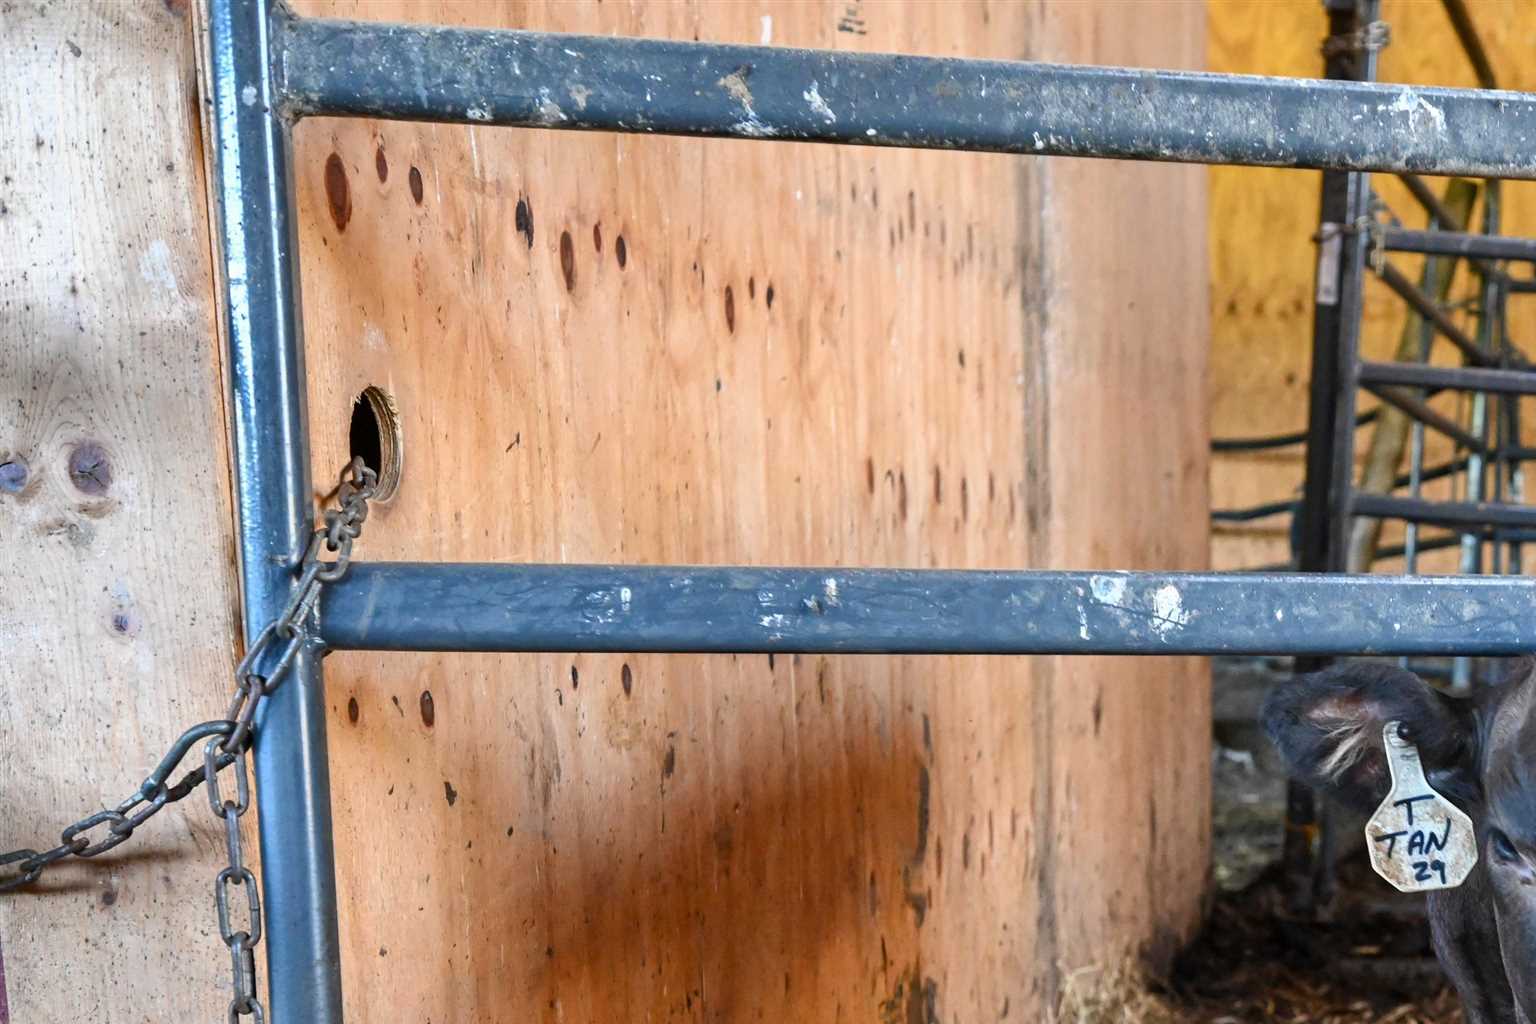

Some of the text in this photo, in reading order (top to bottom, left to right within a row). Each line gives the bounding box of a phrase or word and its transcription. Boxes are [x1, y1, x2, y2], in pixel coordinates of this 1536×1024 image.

[1393, 794, 1435, 826] T
[1375, 818, 1452, 858] TAN
[1412, 860, 1447, 885] 29
